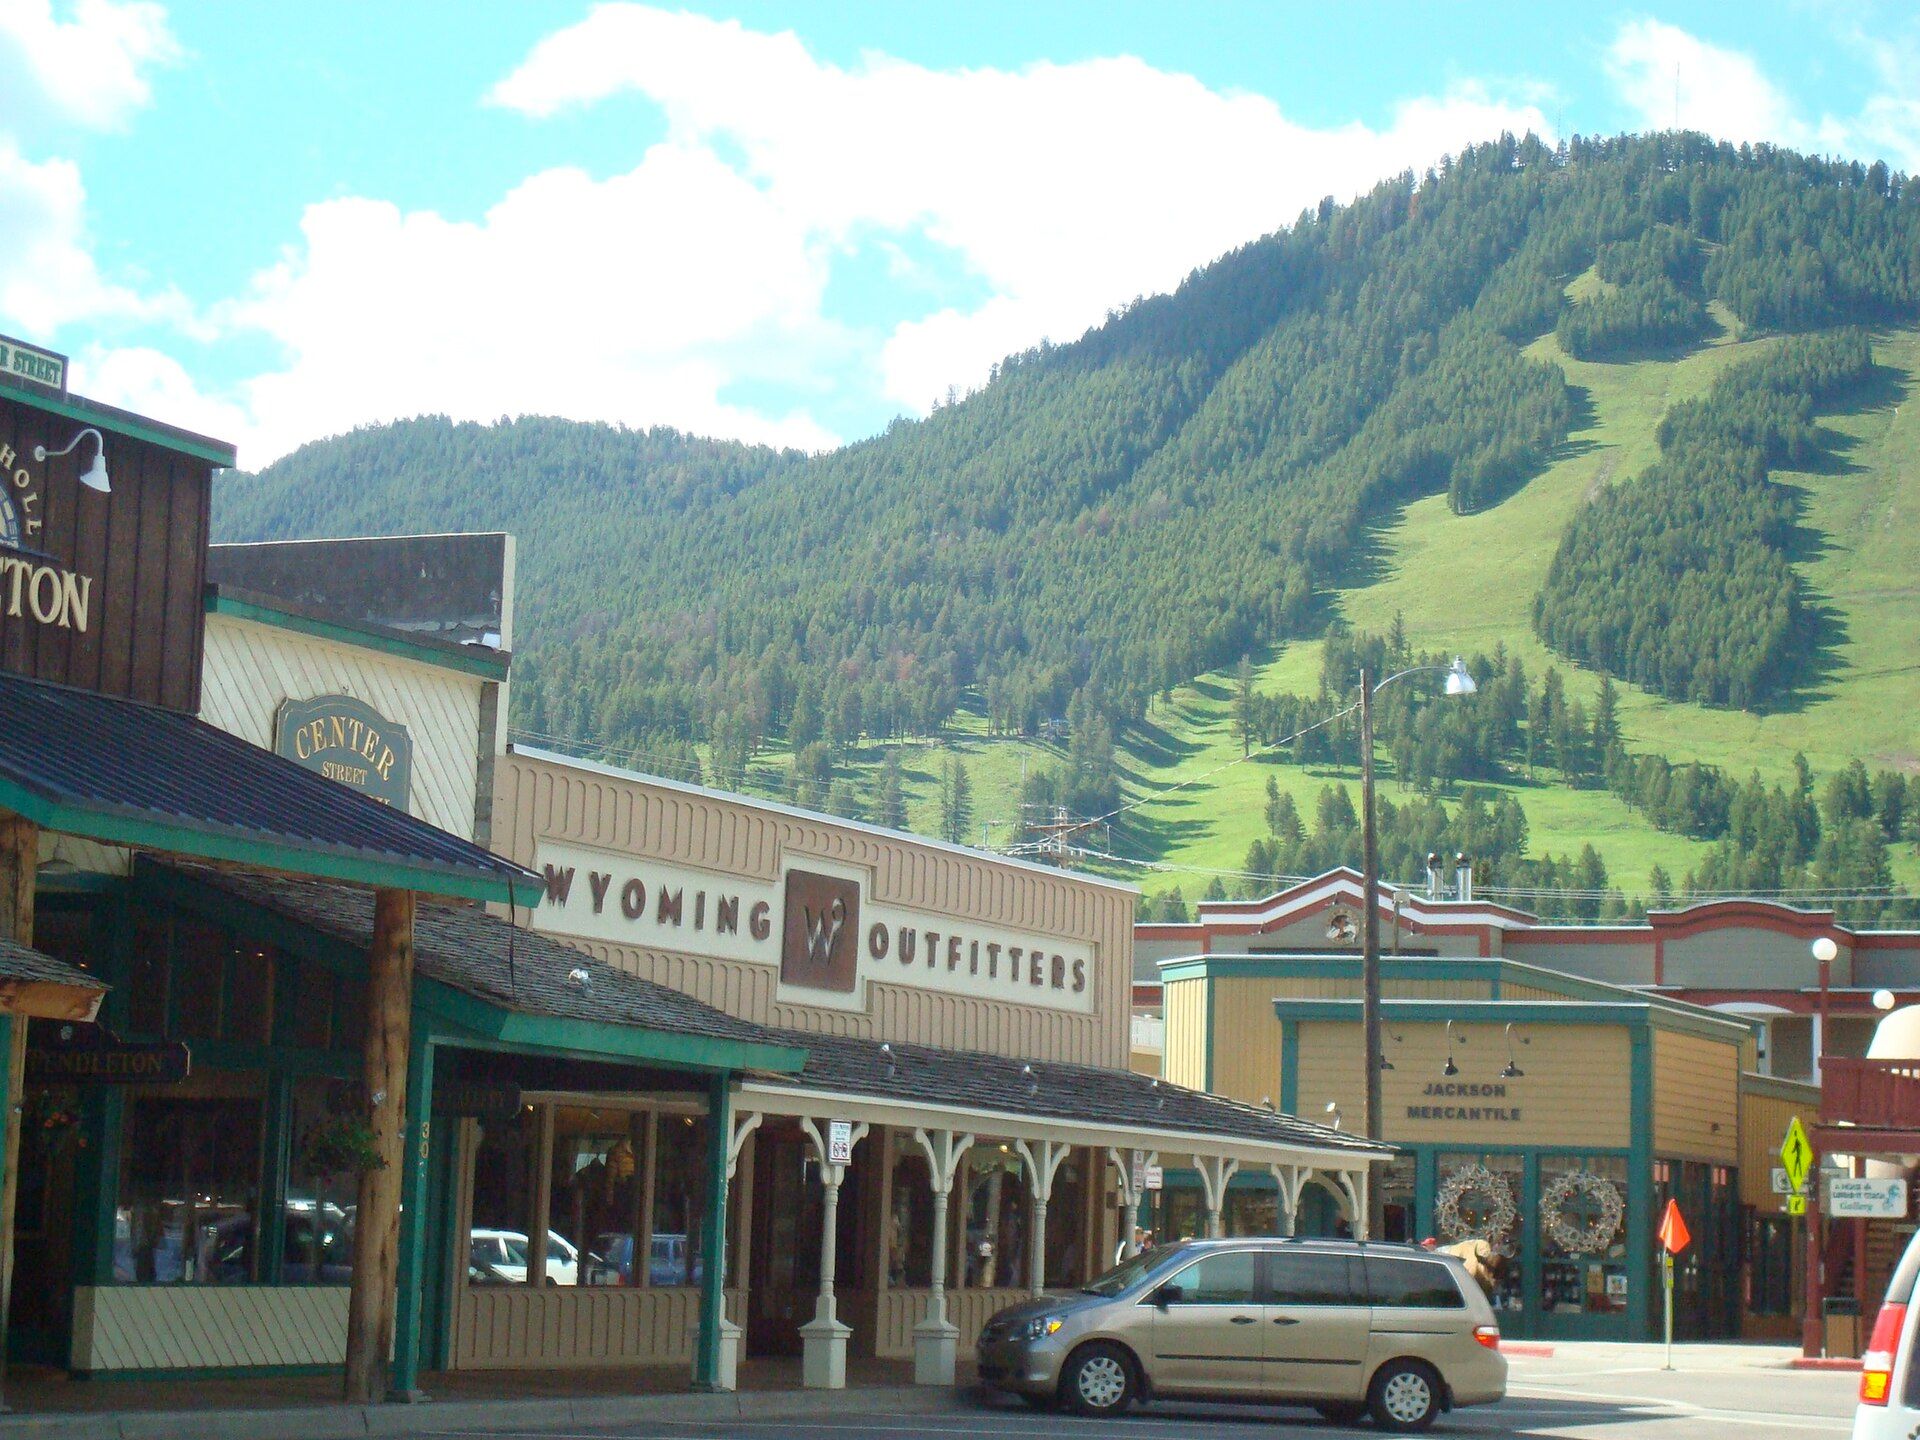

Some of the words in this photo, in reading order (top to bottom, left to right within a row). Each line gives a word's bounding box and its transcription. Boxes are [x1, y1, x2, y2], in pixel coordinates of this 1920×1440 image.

[0, 556, 92, 633] TON
[296, 716, 395, 781] CENTER
[322, 761, 368, 785] STREET
[546, 863, 771, 941] WYOMING
[868, 922, 1086, 993] OUTFITTERS
[1407, 1106, 1521, 1121] MERCANTILE
[1423, 1083, 1506, 1097] JACKSON
